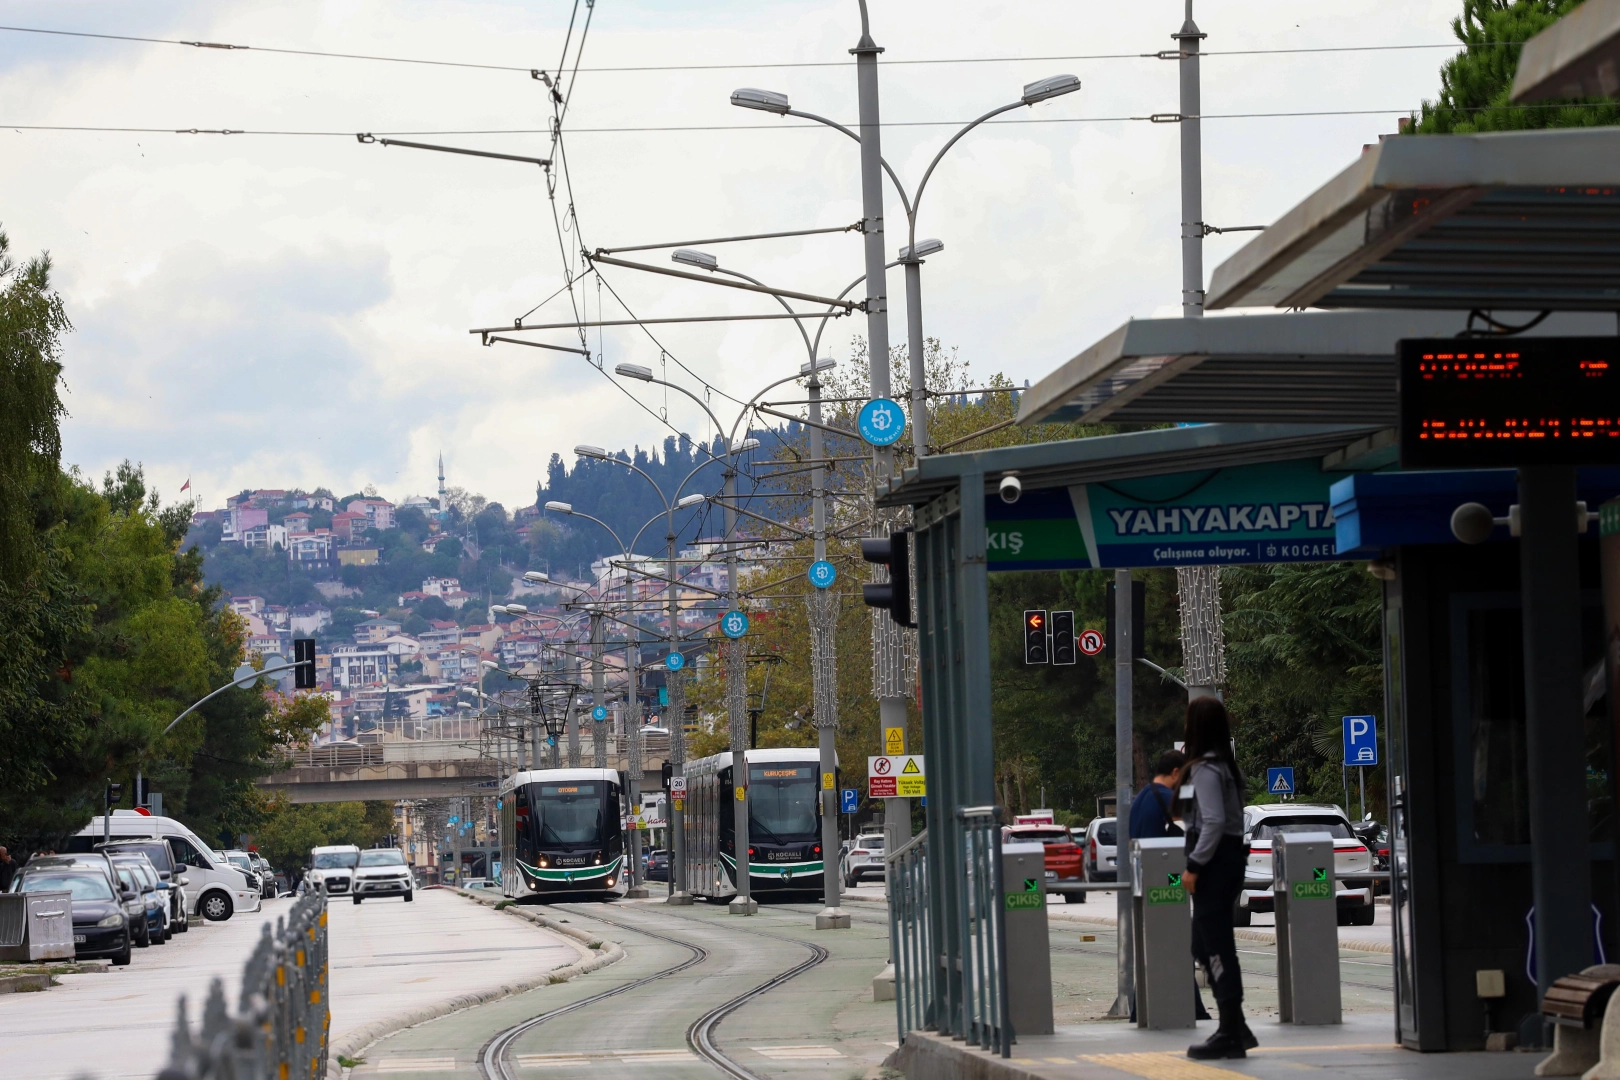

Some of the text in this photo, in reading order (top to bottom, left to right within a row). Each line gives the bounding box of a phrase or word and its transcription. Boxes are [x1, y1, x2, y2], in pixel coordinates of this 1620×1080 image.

[1153, 547, 1205, 562] Çalışınca
[1208, 545, 1251, 560] oluyor.
[1350, 718, 1369, 745] P
[845, 791, 854, 803] P
[1150, 888, 1183, 903] ÇIKIŞ
[1295, 883, 1329, 896] ÇIKIŞ
[1007, 893, 1040, 908] ÇIKIŞ
